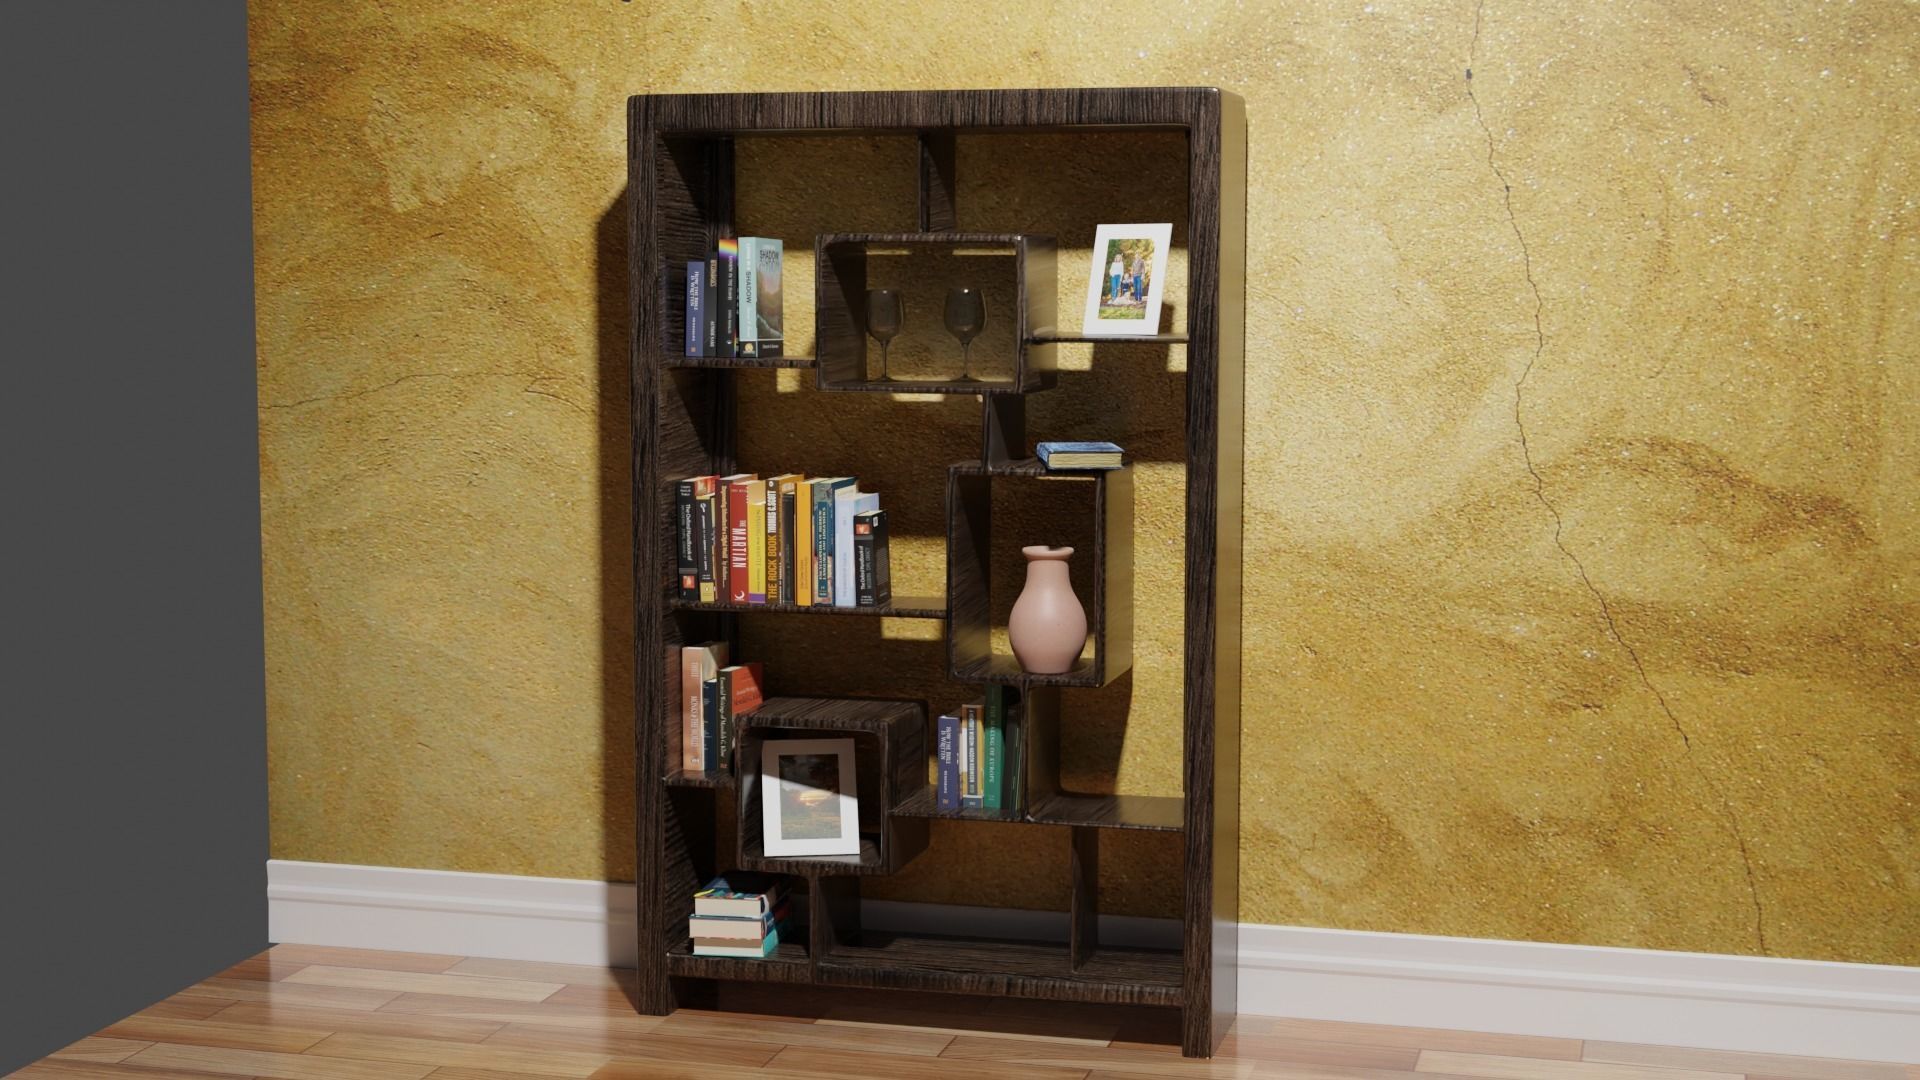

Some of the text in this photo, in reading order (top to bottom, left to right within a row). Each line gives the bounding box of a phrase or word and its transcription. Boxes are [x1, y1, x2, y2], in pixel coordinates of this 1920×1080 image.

[732, 528, 747, 568] MARTIAN
[767, 534, 777, 557] BOOK
[767, 559, 777, 581] ROCK
[767, 583, 778, 600] THE
